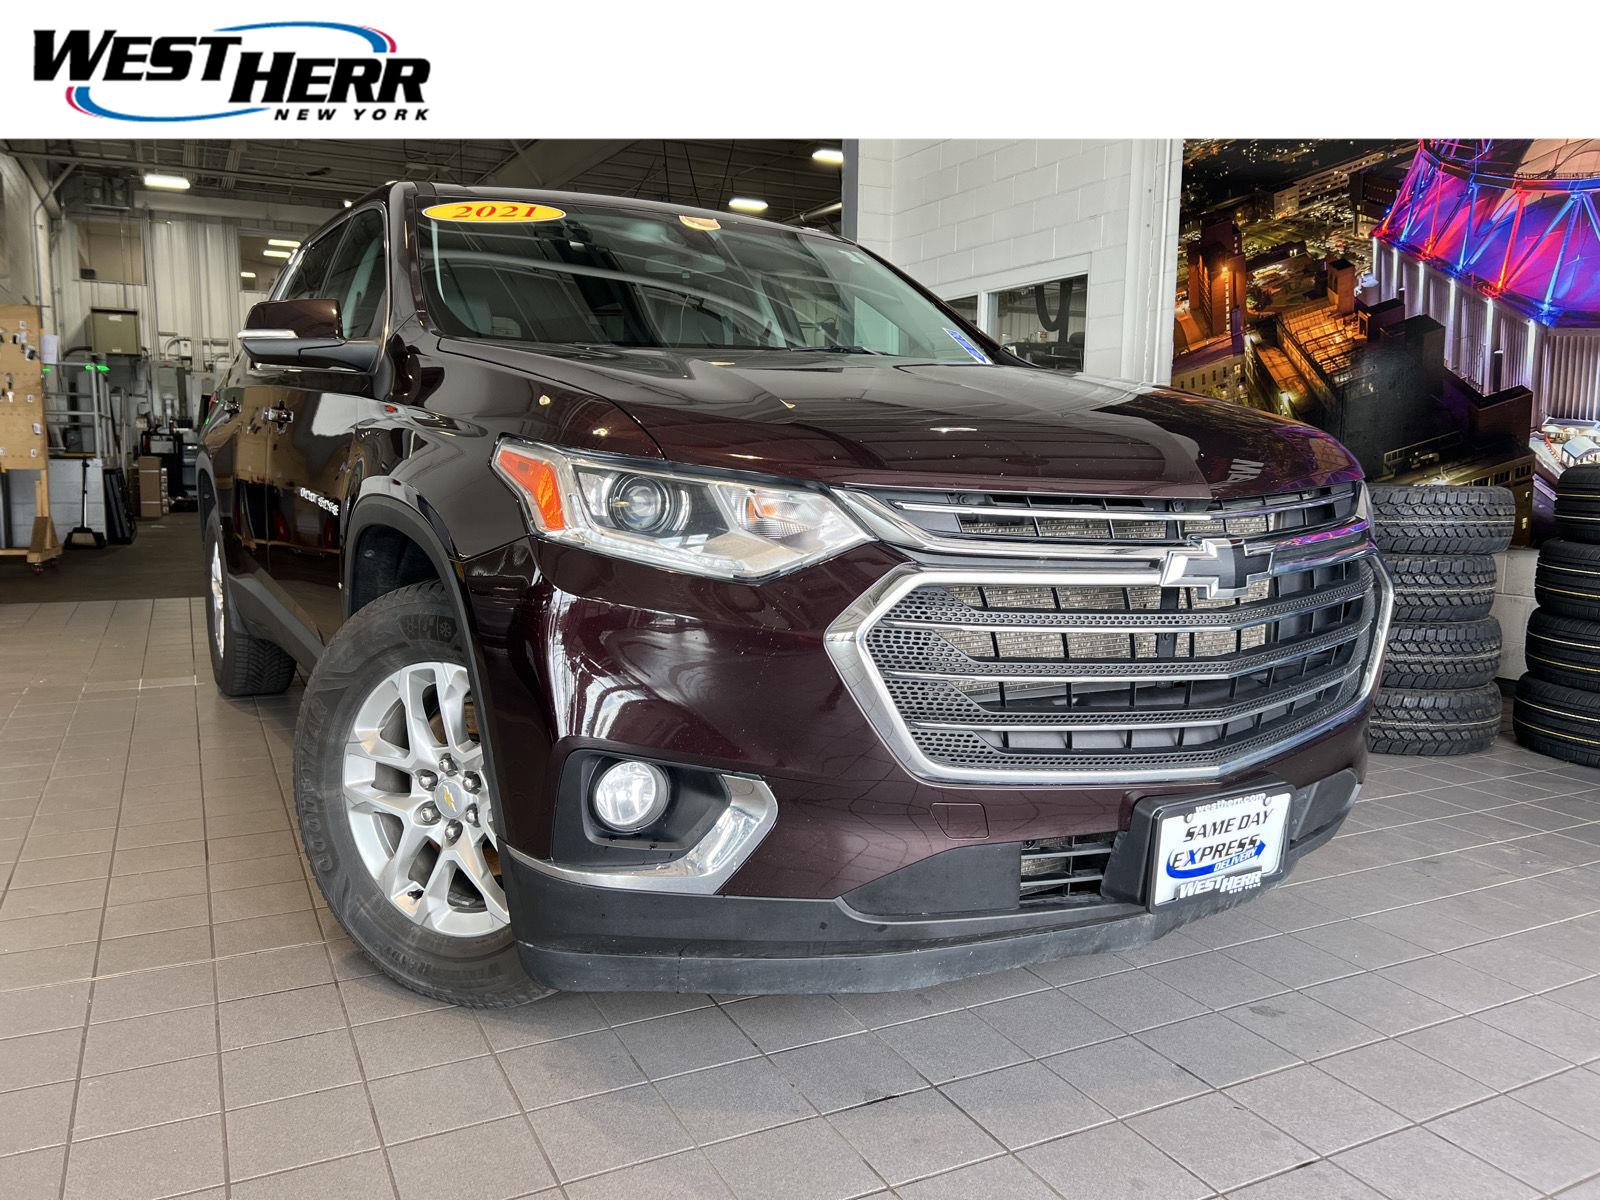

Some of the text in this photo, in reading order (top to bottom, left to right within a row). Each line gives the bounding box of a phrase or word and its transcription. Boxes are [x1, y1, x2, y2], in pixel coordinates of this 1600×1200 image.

[452, 205, 538, 219] 2021
[1184, 808, 1274, 842] SAME DAY
[1172, 833, 1261, 870] EXPRESS
[1213, 847, 1257, 872] DELIVERY
